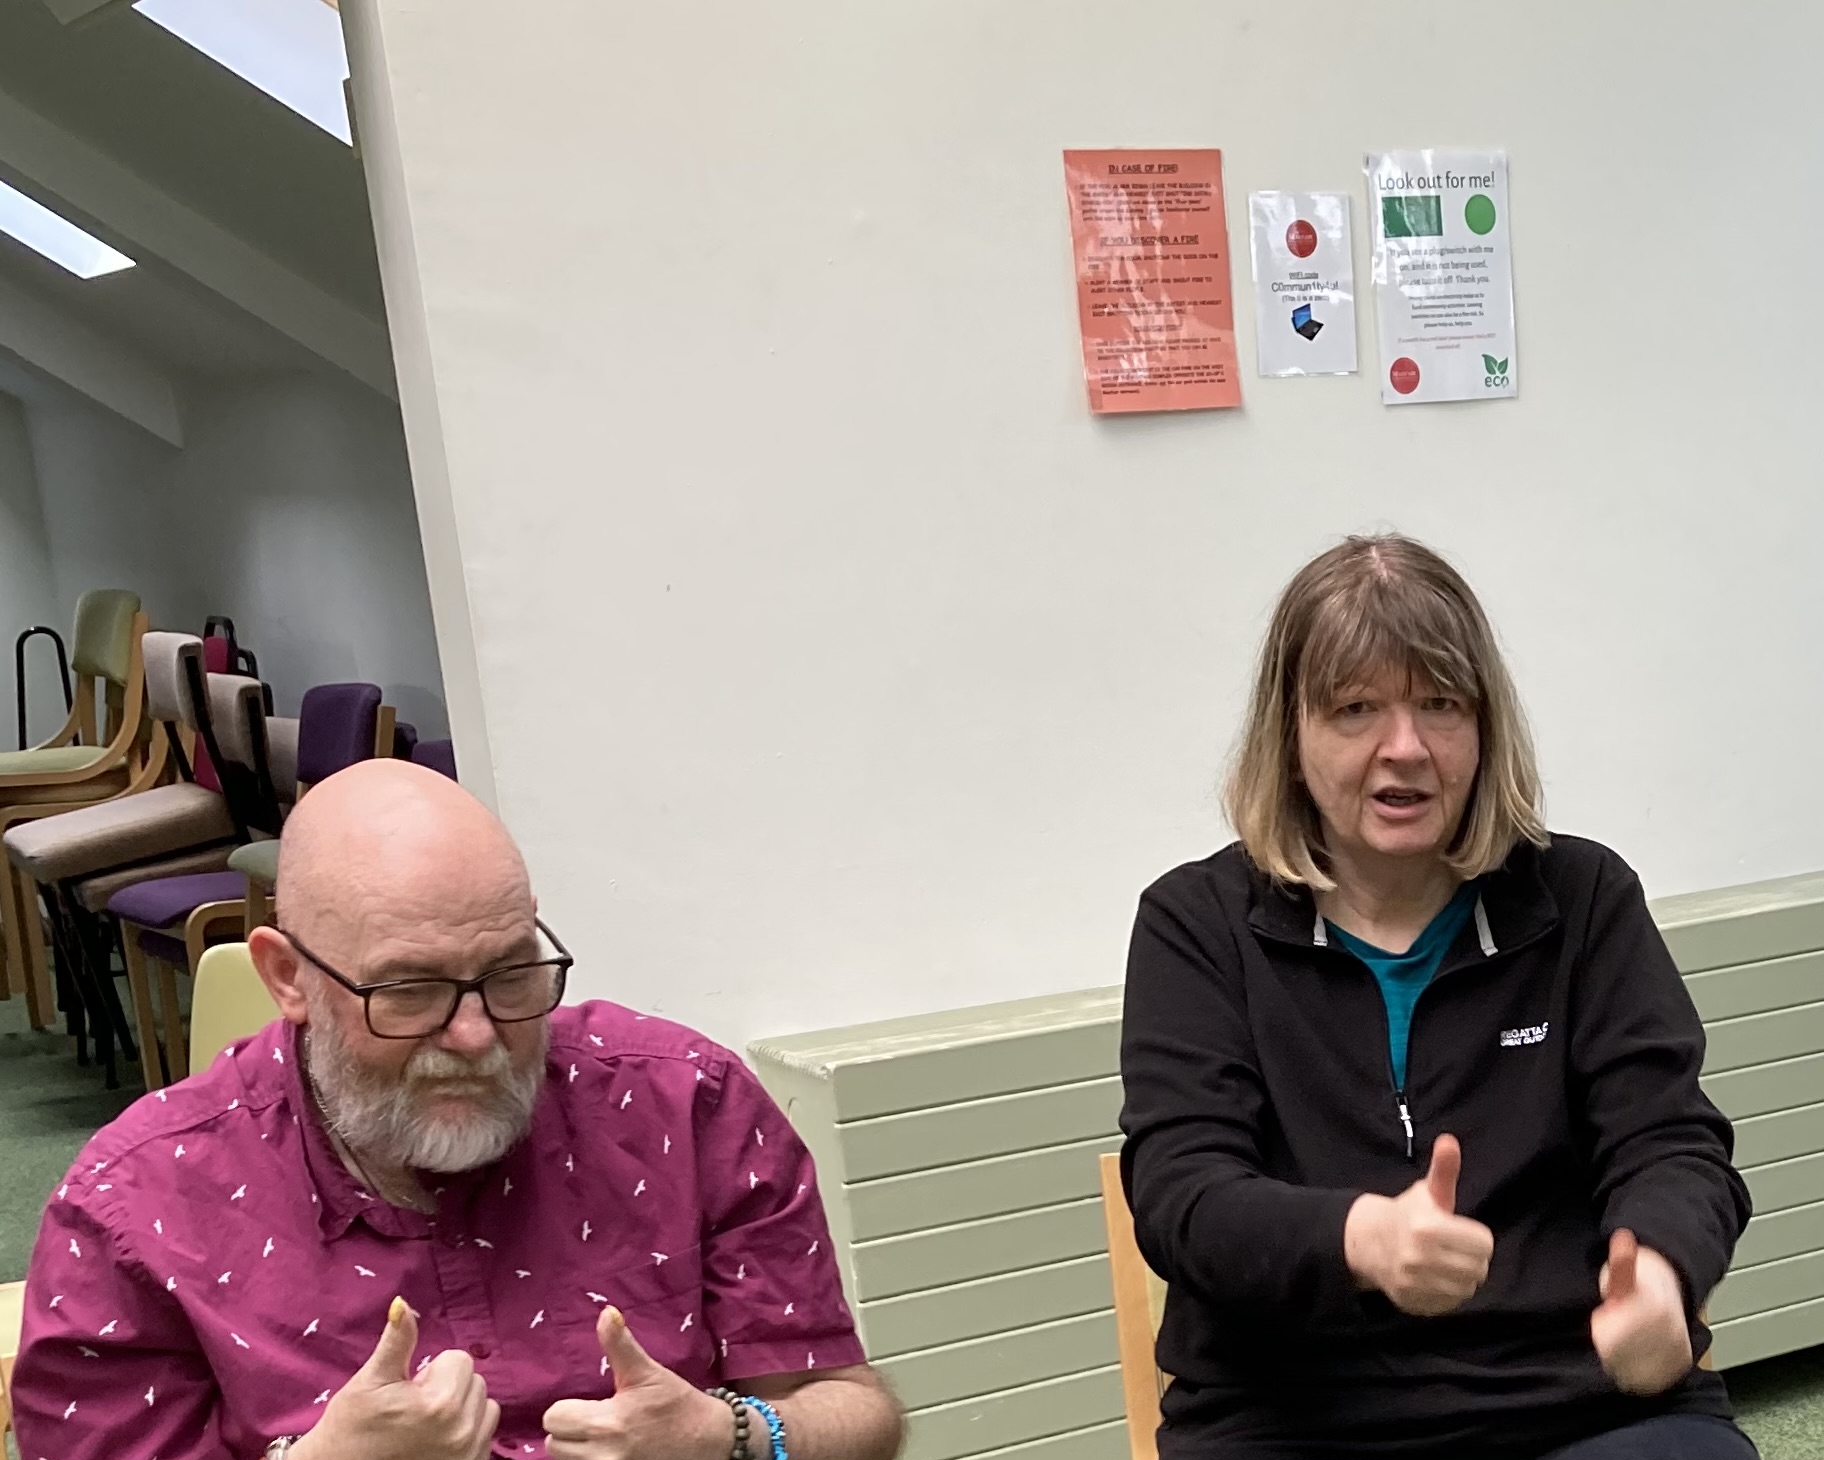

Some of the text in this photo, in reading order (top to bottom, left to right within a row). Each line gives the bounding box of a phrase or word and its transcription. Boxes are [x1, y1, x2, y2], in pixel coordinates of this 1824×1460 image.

[1121, 163, 1141, 173] CASE
[1144, 163, 1154, 173] OF
[1157, 163, 1178, 173] FIRE
[1378, 170, 1495, 190] Look out for me!
[1456, 275, 1476, 283] Thank
[1484, 375, 1509, 389] eco
